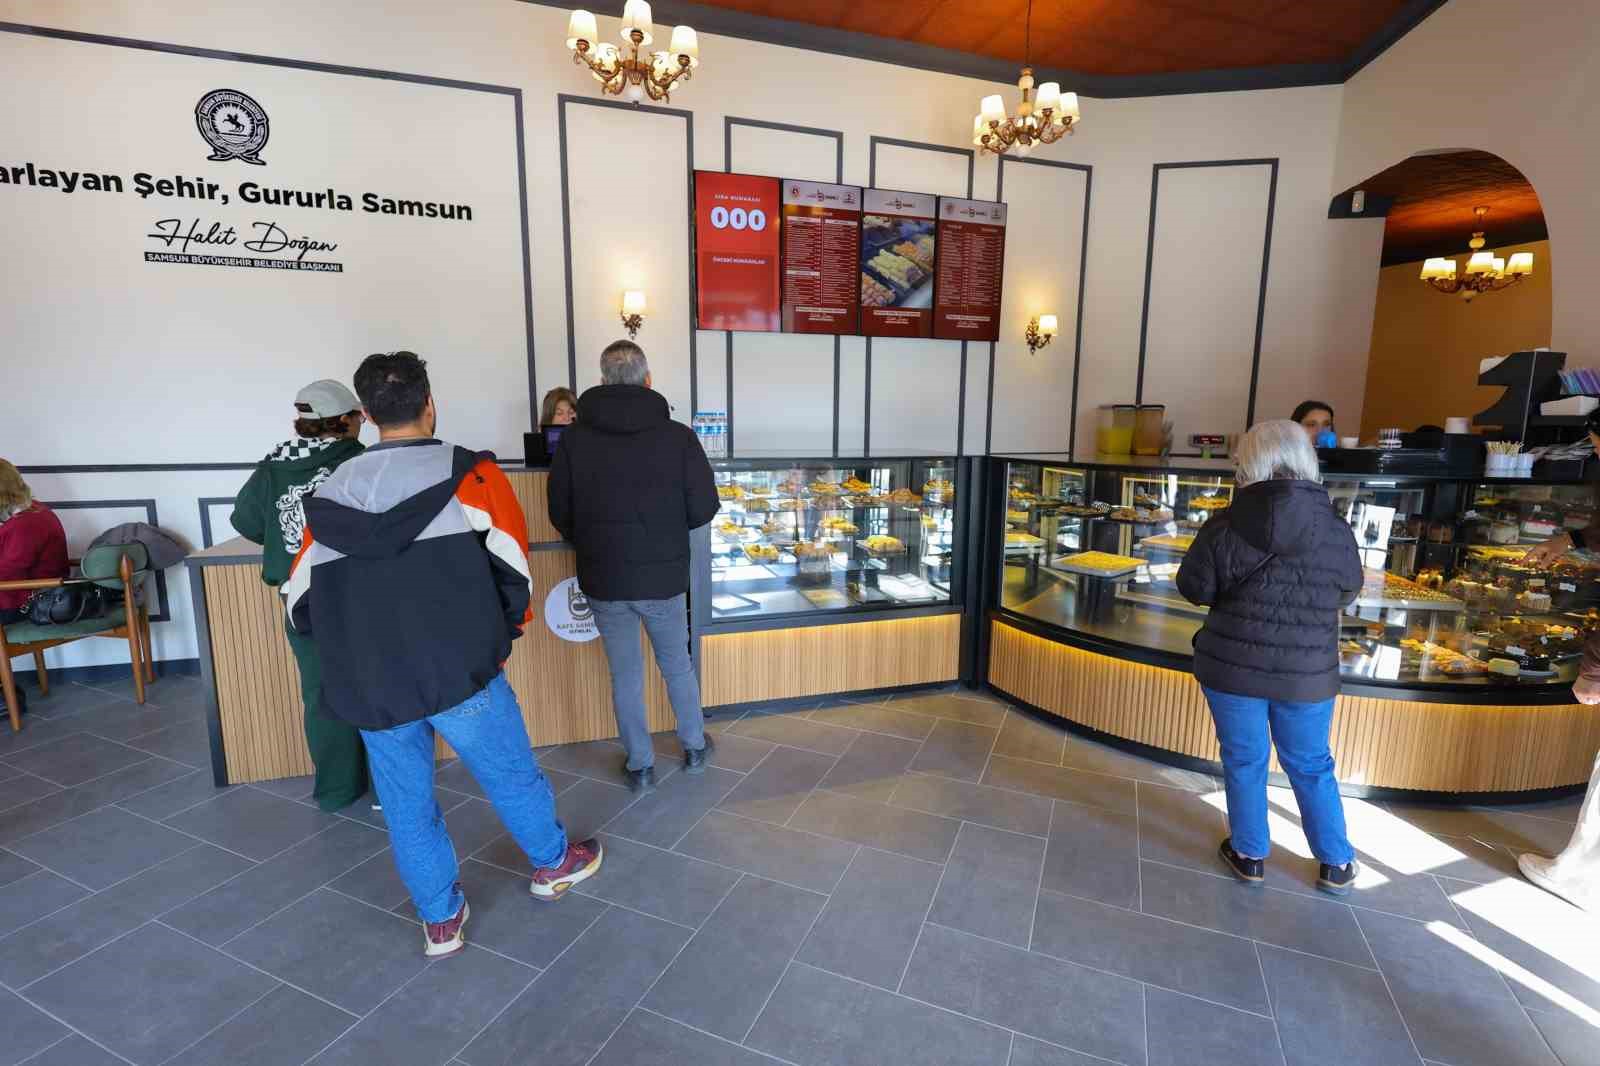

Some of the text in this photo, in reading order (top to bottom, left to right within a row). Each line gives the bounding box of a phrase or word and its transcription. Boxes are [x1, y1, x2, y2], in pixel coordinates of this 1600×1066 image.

[133, 172, 230, 206] Şehir,
[239, 182, 353, 211] Gururla
[363, 192, 472, 221] Samsun
[711, 206, 766, 231] 000
[147, 218, 338, 261] Halit Doğan
[148, 253, 190, 263] SAMSUN
[254, 259, 299, 270] BELEDİYE
[300, 263, 341, 273] BAŞKANI
